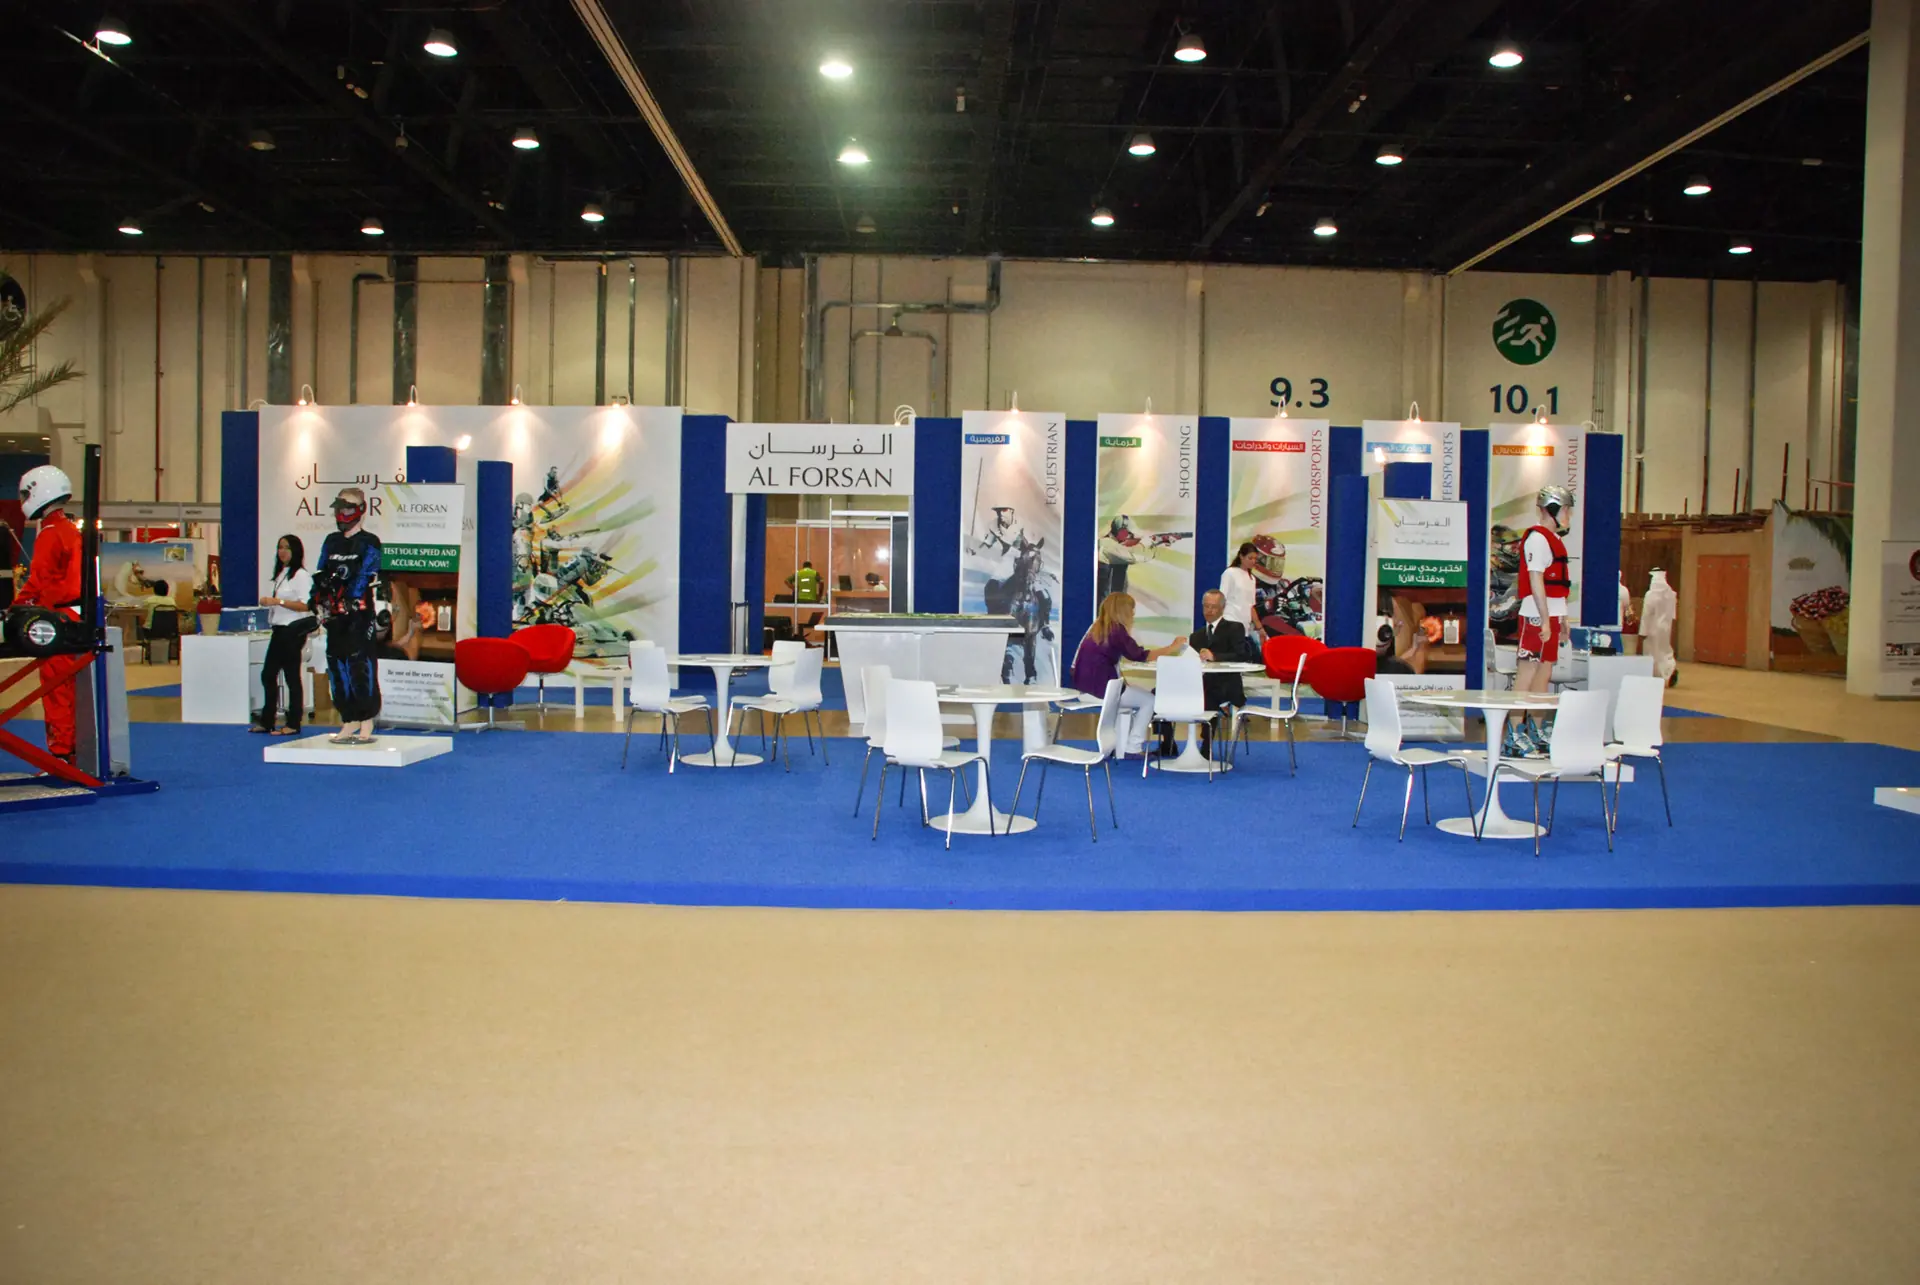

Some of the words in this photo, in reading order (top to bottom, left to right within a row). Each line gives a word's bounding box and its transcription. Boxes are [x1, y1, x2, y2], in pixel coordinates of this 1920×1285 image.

[1270, 377, 1330, 409] 9.3
[1490, 384, 1558, 415] 10.1
[748, 432, 893, 461] الفرسان
[969, 434, 1006, 444] الفروسية
[1105, 437, 1137, 447] الرماية
[1045, 422, 1057, 505] EQUESTRIAN
[1179, 425, 1192, 499] SHOOTING
[1442, 431, 1454, 500] TERSPORTS
[1567, 436, 1579, 502] AINTBALL
[295, 463, 406, 490] فرسان
[748, 466, 779, 487] AL
[789, 466, 893, 488] FORSAN
[1310, 429, 1323, 528] MOTORSPORTS
[295, 497, 326, 517] AL
[396, 503, 407, 513] AL
[410, 503, 448, 513] FORSAN
[384, 547, 398, 555] TEST
[398, 547, 418, 556] YOUR
[419, 548, 440, 557] SPEED
[441, 549, 457, 557] AND
[390, 558, 428, 568] ACCURACY
[428, 559, 450, 569] NOW!
[1382, 563, 1417, 572] سرعتك
[1438, 565, 1463, 574] اختبر
